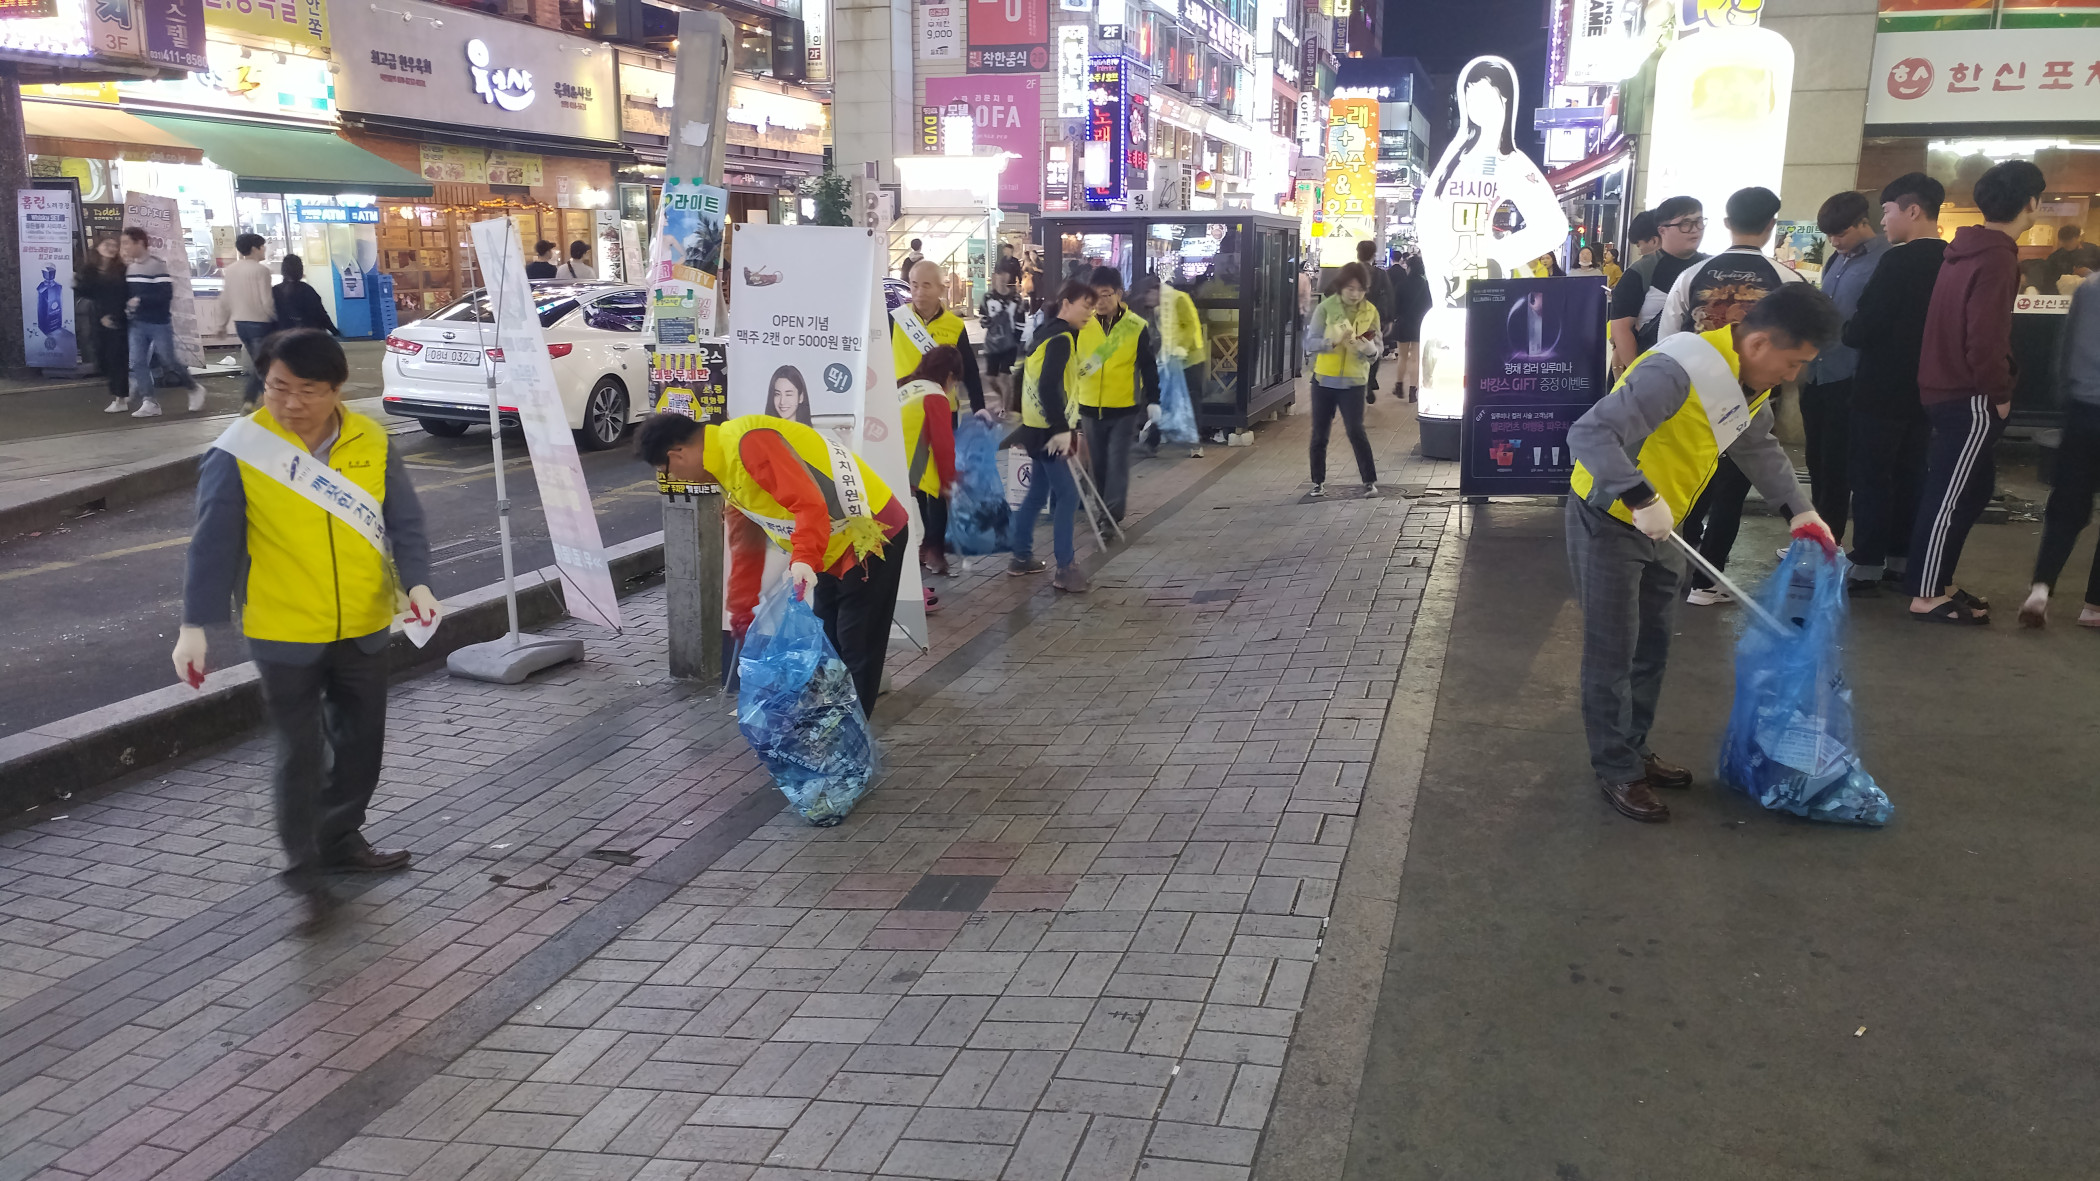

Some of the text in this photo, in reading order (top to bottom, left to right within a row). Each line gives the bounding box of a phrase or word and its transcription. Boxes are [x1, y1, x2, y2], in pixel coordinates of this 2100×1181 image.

[927, 29, 953, 39] 9,000
[1103, 26, 1119, 38] 2F
[105, 34, 129, 51] 3F
[808, 49, 820, 60] 2F
[983, 51, 1027, 68] 착한중식
[1026, 80, 1037, 89] 2F
[947, 103, 969, 116] 모텔
[1328, 106, 1370, 129] 노래
[923, 116, 938, 145] DVD
[1326, 150, 1367, 173] 소주
[1450, 180, 1498, 198] 러시아
[22, 196, 45, 210] 홈런
[674, 194, 719, 214] 라이트
[321, 208, 347, 221] ATM
[357, 211, 379, 222] ATM
[772, 314, 829, 331] OPEN 기념
[737, 330, 862, 352] 맥주 2캔 or 5000원 할인
[675, 369, 709, 381] 무제한
[1505, 362, 1573, 376] 광채 컬러 일루미나
[828, 366, 849, 391] 딱!
[1480, 376, 1590, 392] 바캉스 GIFT 증정 이벤트
[1475, 409, 1487, 422] GIFT
[1490, 412, 1511, 420] 일루미나
